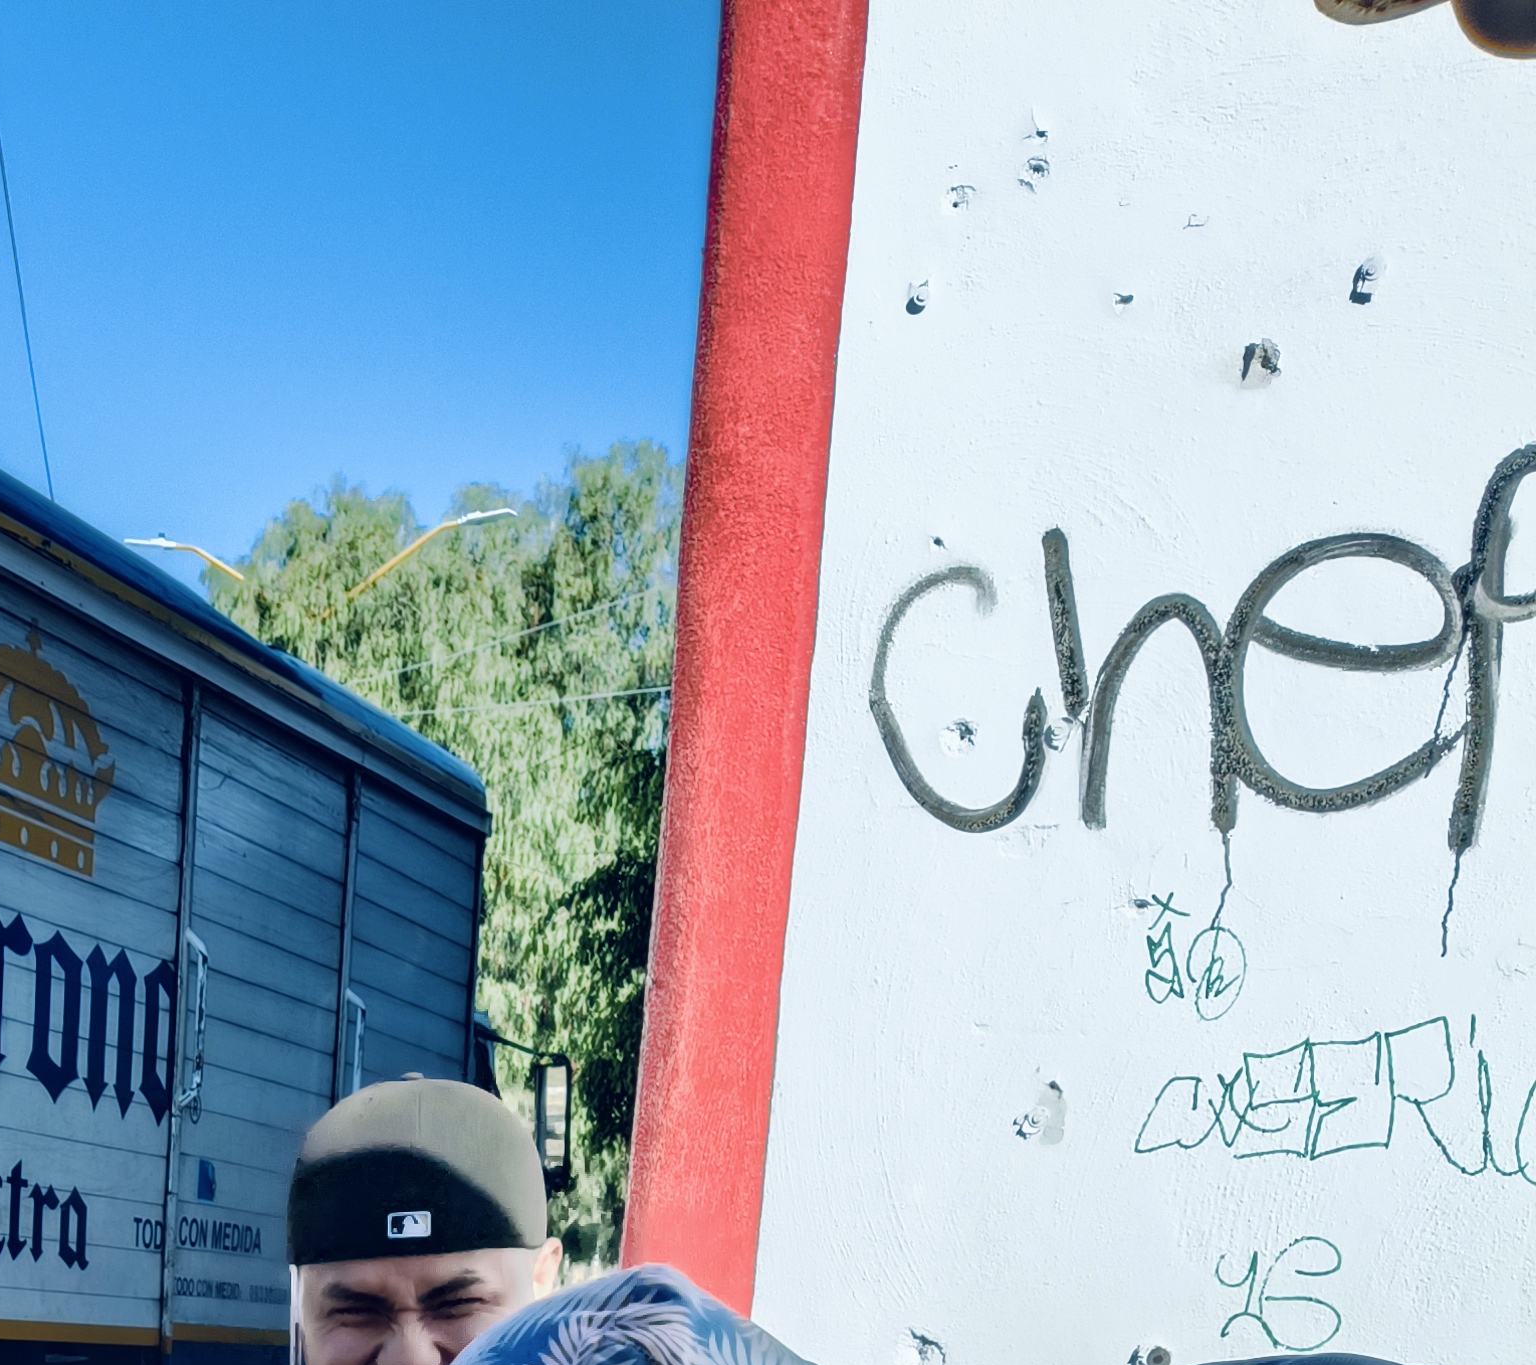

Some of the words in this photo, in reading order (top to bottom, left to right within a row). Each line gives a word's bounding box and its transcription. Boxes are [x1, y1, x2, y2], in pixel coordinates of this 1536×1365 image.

[133, 1216, 165, 1250] TOD
[178, 1215, 209, 1249] CON
[211, 1219, 263, 1255] MEDIDA
